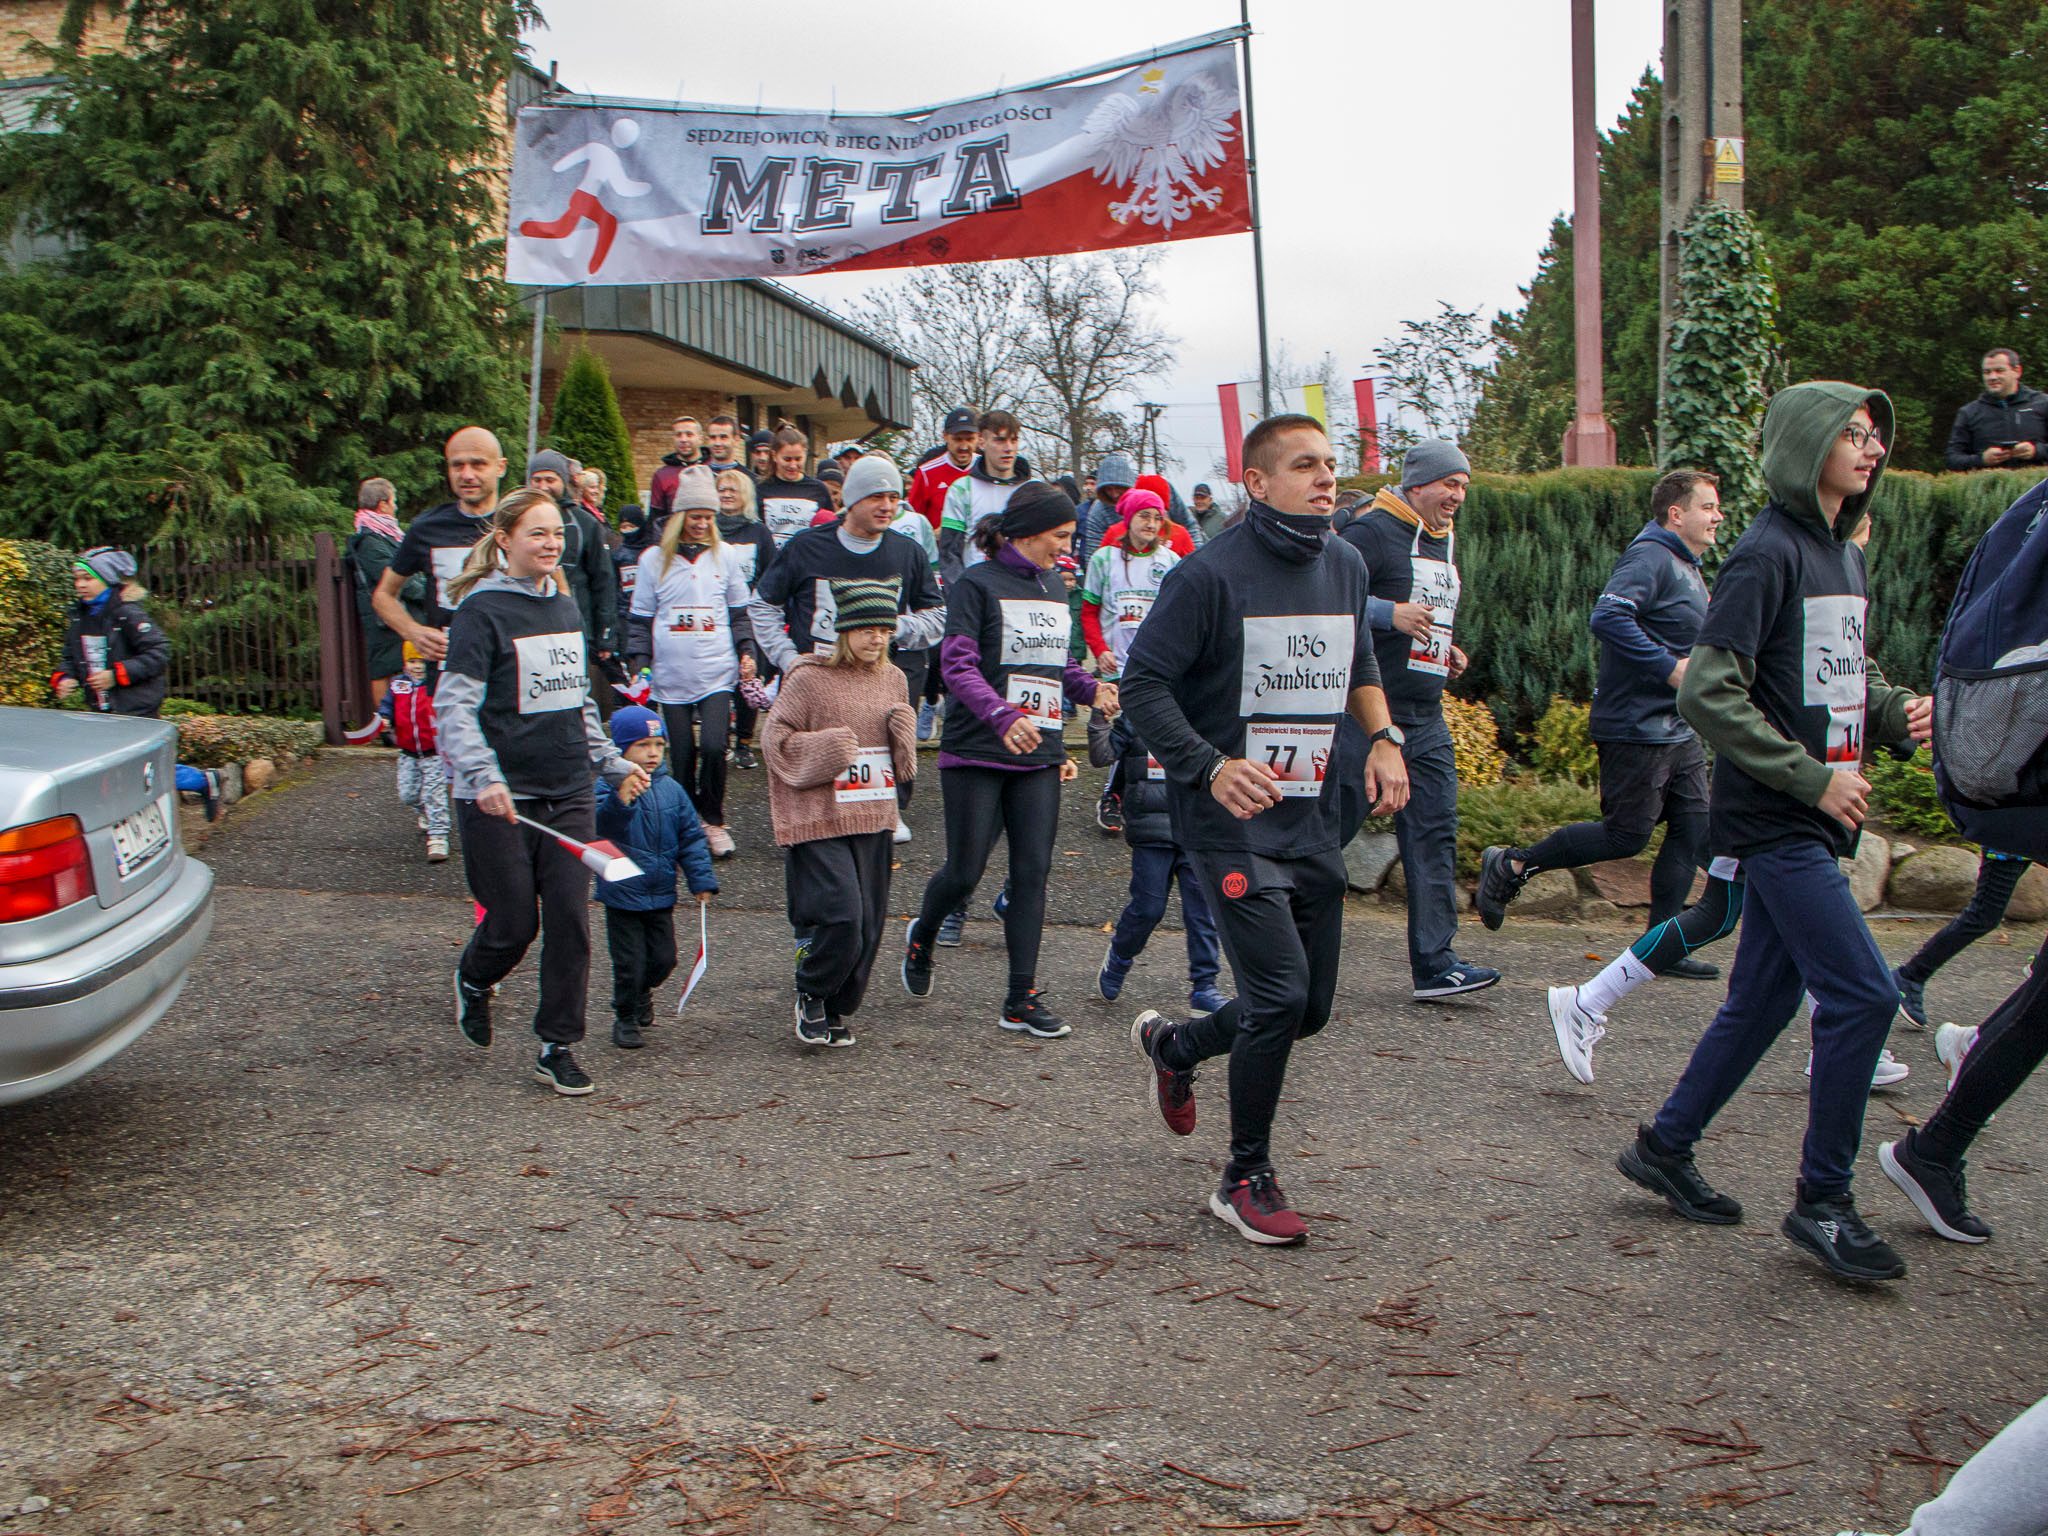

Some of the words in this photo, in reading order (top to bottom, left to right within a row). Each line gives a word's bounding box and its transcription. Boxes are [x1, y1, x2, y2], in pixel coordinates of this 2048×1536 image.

[836, 134, 881, 151] BIEG
[700, 133, 1022, 235] META
[1028, 612, 1057, 628] 1136
[1287, 633, 1326, 658] 1136
[1423, 641, 1440, 659] 23
[548, 647, 579, 666] 1136
[1020, 690, 1041, 711] 29
[1844, 722, 1860, 753] 14
[1265, 745, 1298, 774] 77
[848, 764, 871, 785] 60
